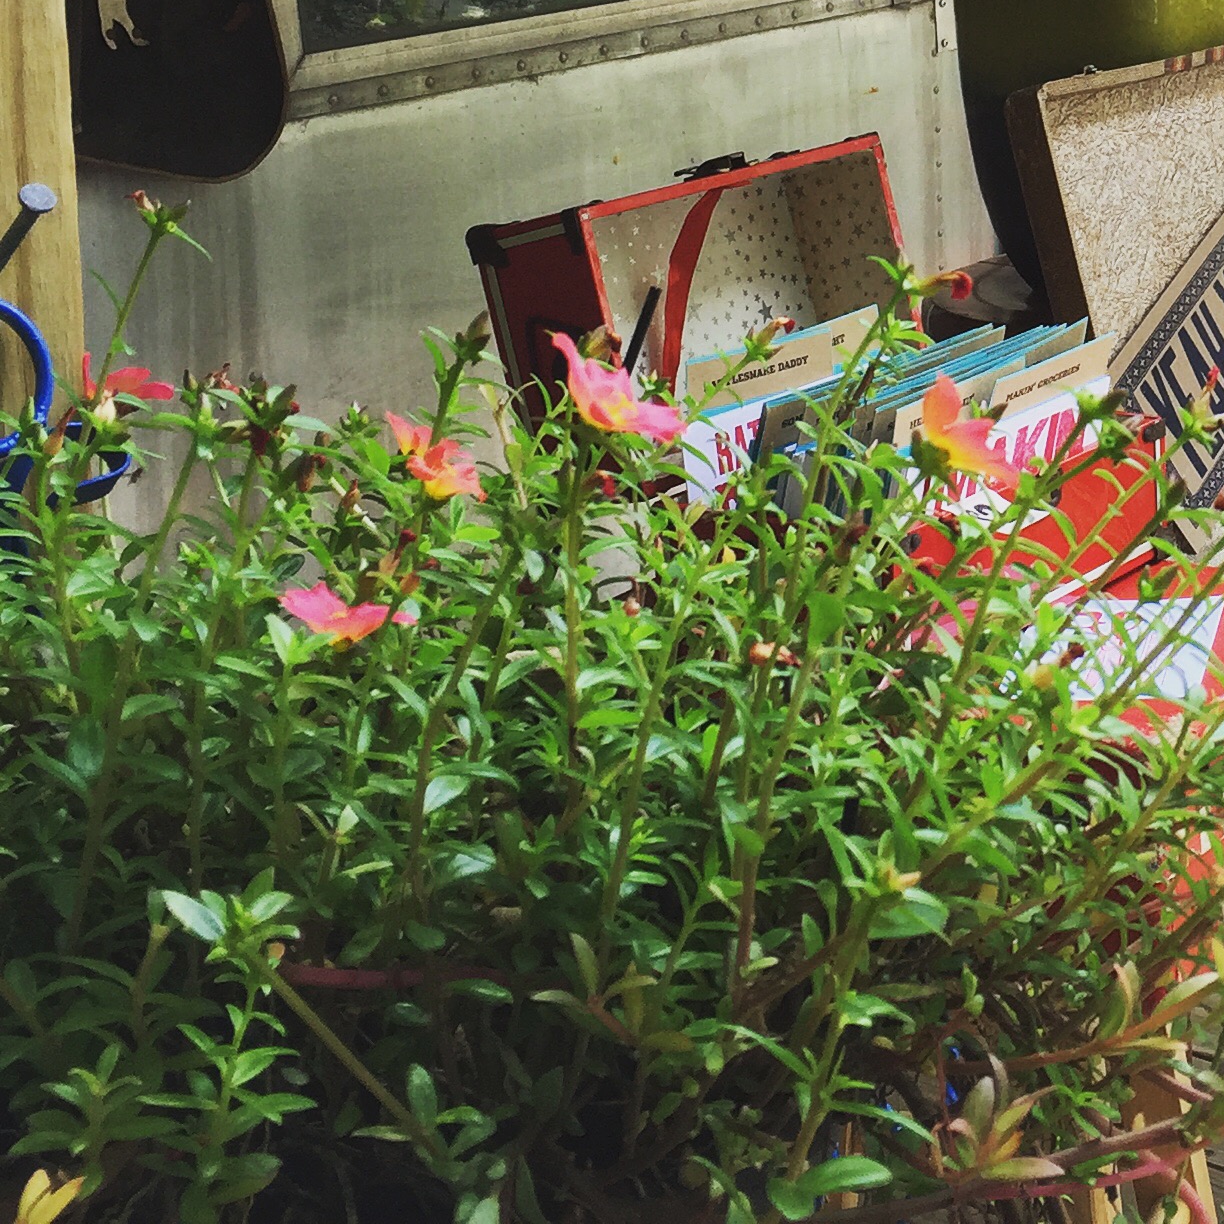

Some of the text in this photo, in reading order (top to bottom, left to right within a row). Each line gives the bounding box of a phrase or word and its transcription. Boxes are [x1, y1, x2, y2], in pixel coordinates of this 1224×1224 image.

[711, 355, 809, 387] ALESNAKE DADDY
[1037, 363, 1081, 390] GROCERIES
